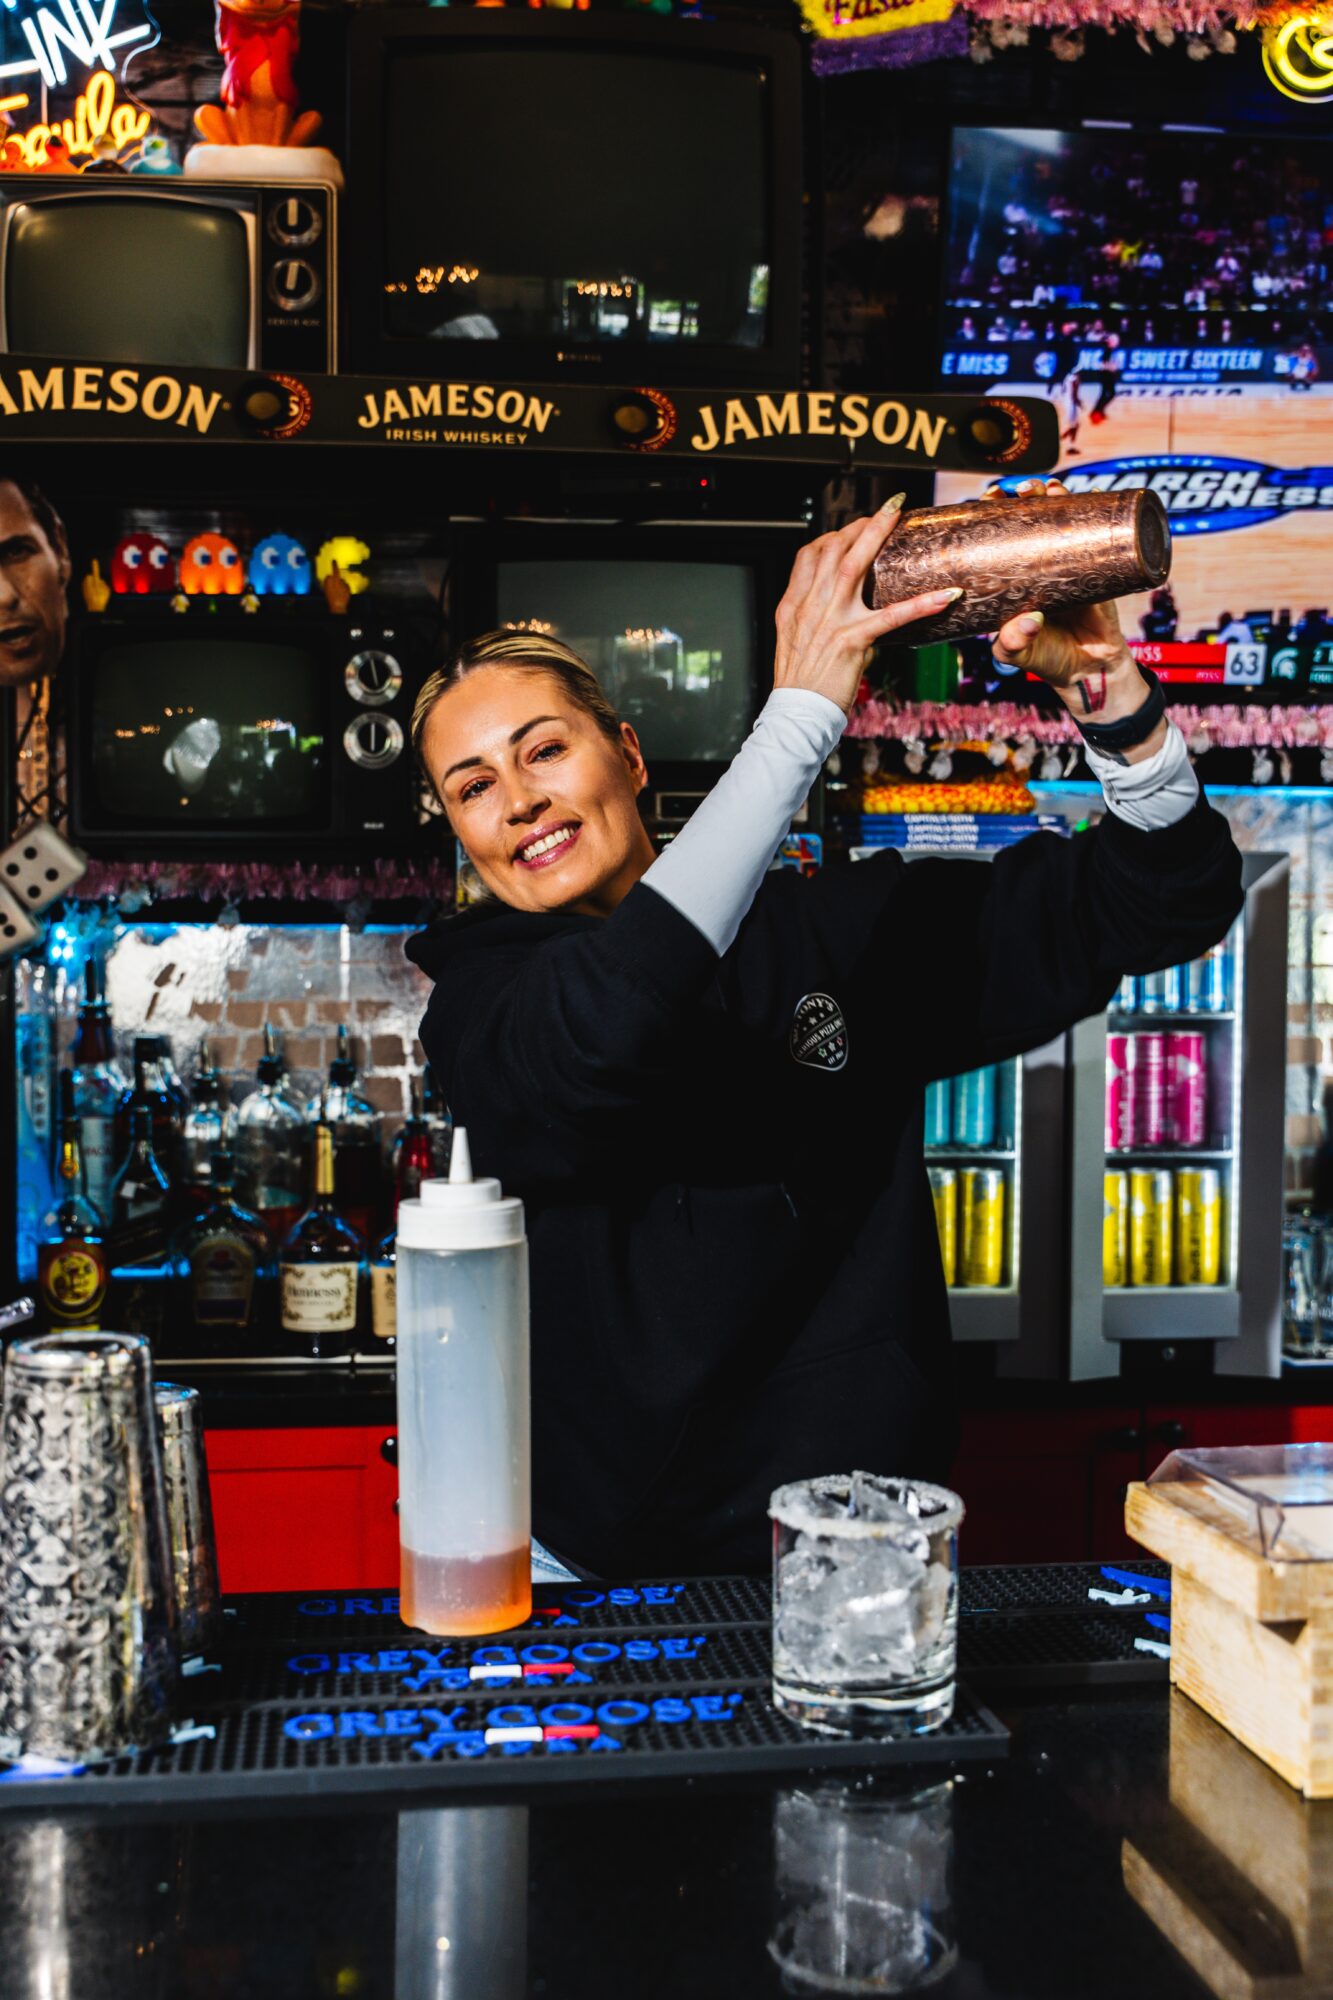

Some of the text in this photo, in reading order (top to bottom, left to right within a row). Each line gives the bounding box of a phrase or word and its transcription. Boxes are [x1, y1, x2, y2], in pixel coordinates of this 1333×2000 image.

[0, 0, 150, 88] INK
[957, 352, 1008, 375] MISS
[1078, 349, 1263, 371] NCA SWEET SIXTEEN
[0, 367, 222, 433] AMESON
[358, 384, 554, 433] JAMESON
[386, 428, 528, 445] IRISH WHISKEY
[691, 392, 947, 458] JAMESON
[1064, 471, 1261, 493] MARCH
[1230, 651, 1260, 676] 63
[298, 1597, 400, 1616] GRE
[287, 1637, 698, 1675] GREY GOOSE
[283, 1695, 734, 1741] GREY GOOSE
